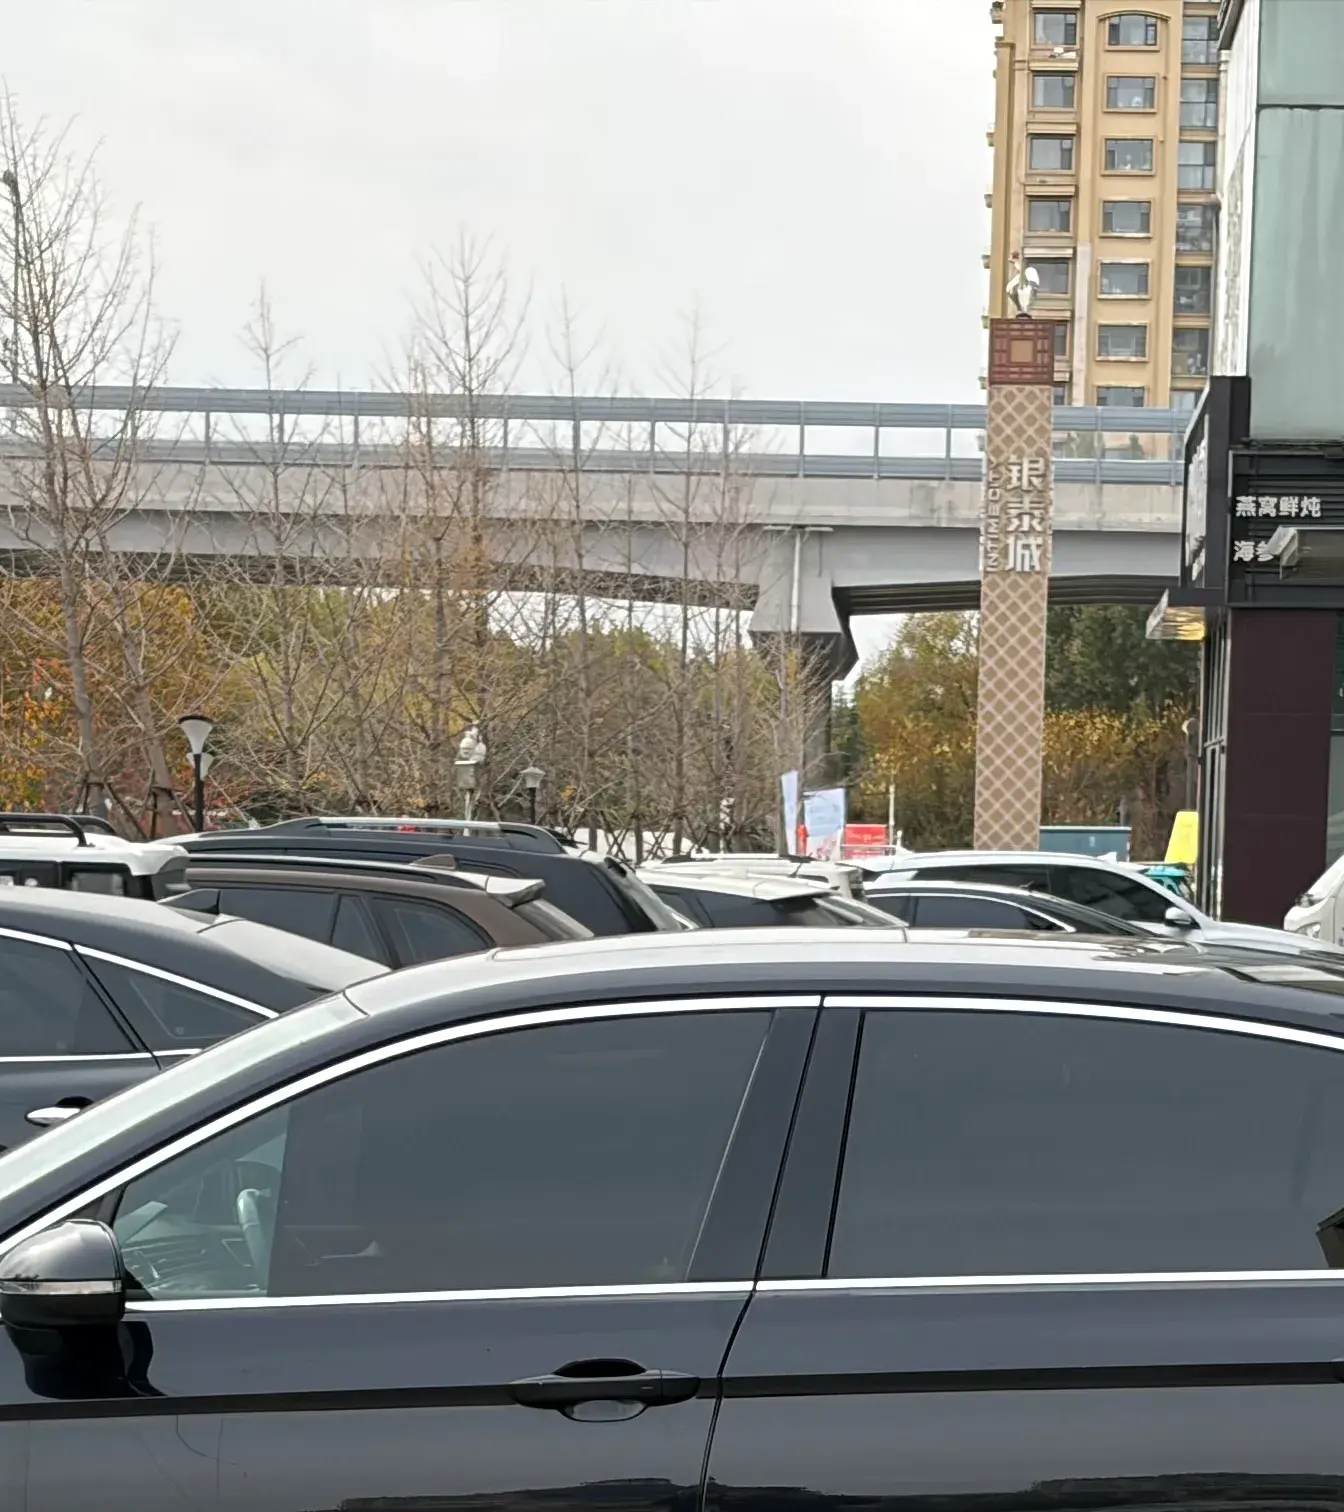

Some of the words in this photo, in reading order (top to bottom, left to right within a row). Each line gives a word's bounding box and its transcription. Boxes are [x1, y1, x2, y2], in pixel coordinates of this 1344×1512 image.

[1006, 454, 1046, 573] 银泰城
[1235, 495, 1322, 518] 燕窝鲜炖
